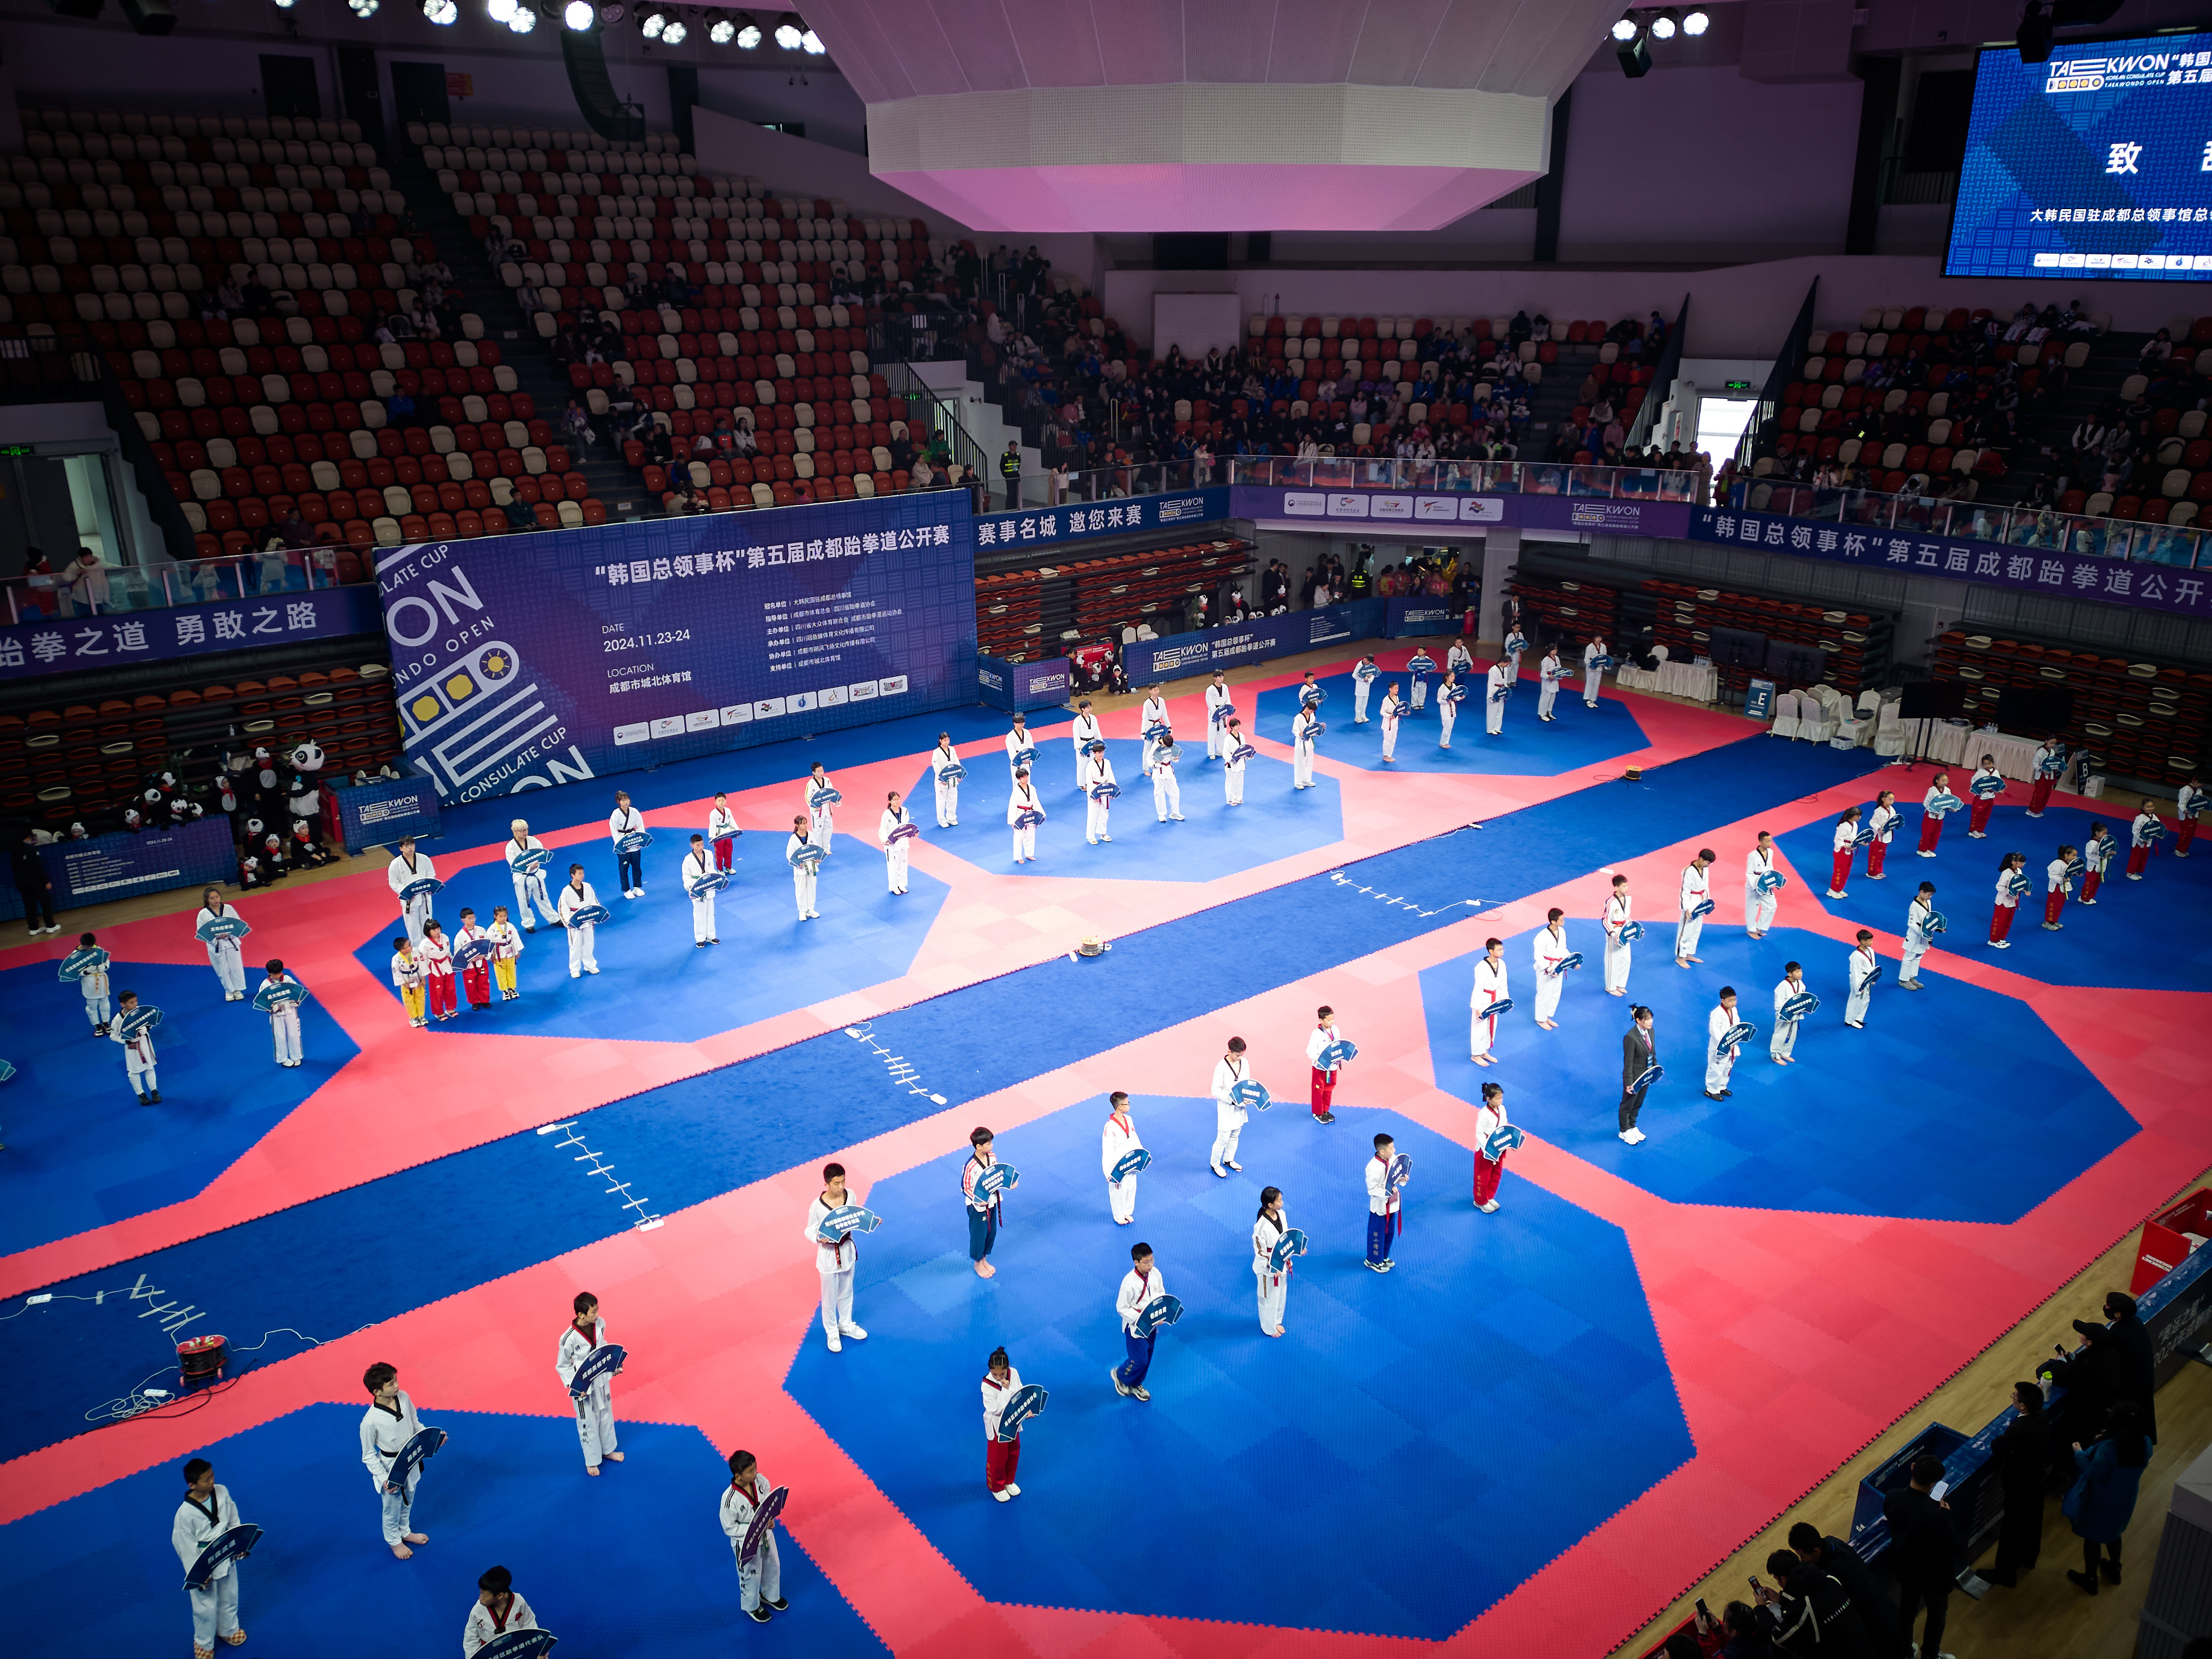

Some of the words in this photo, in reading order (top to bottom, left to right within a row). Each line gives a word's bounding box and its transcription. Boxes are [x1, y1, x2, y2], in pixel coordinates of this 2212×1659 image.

[2049, 54, 2169, 77] TAEKWON
[2172, 51, 2212, 68] “韩国
[2105, 142, 2143, 175] 致
[2029, 208, 2212, 222] 大韩民国驻成都总领事馆总
[978, 515, 1057, 546] 赛事名城
[1069, 504, 1142, 533] 邀您来赛
[421, 545, 449, 568] CUP
[595, 524, 950, 586] “韩国总领事杯”第五届成都跆拳道公开赛
[1702, 514, 2212, 606] “韩国总领事杯”第五届成都跆拳道公开
[175, 601, 318, 646] 勇敢之路
[445, 616, 495, 653] OPEN
[602, 623, 624, 634] DATE
[603, 629, 691, 652] 2024.11.23-24
[607, 663, 654, 678] LOCATION
[609, 671, 692, 694] 成都市城北体育馆
[1758, 692, 1767, 706] E
[460, 745, 540, 804] CONSULATE
[540, 727, 567, 750] CUP
[2082, 762, 2088, 777] B
